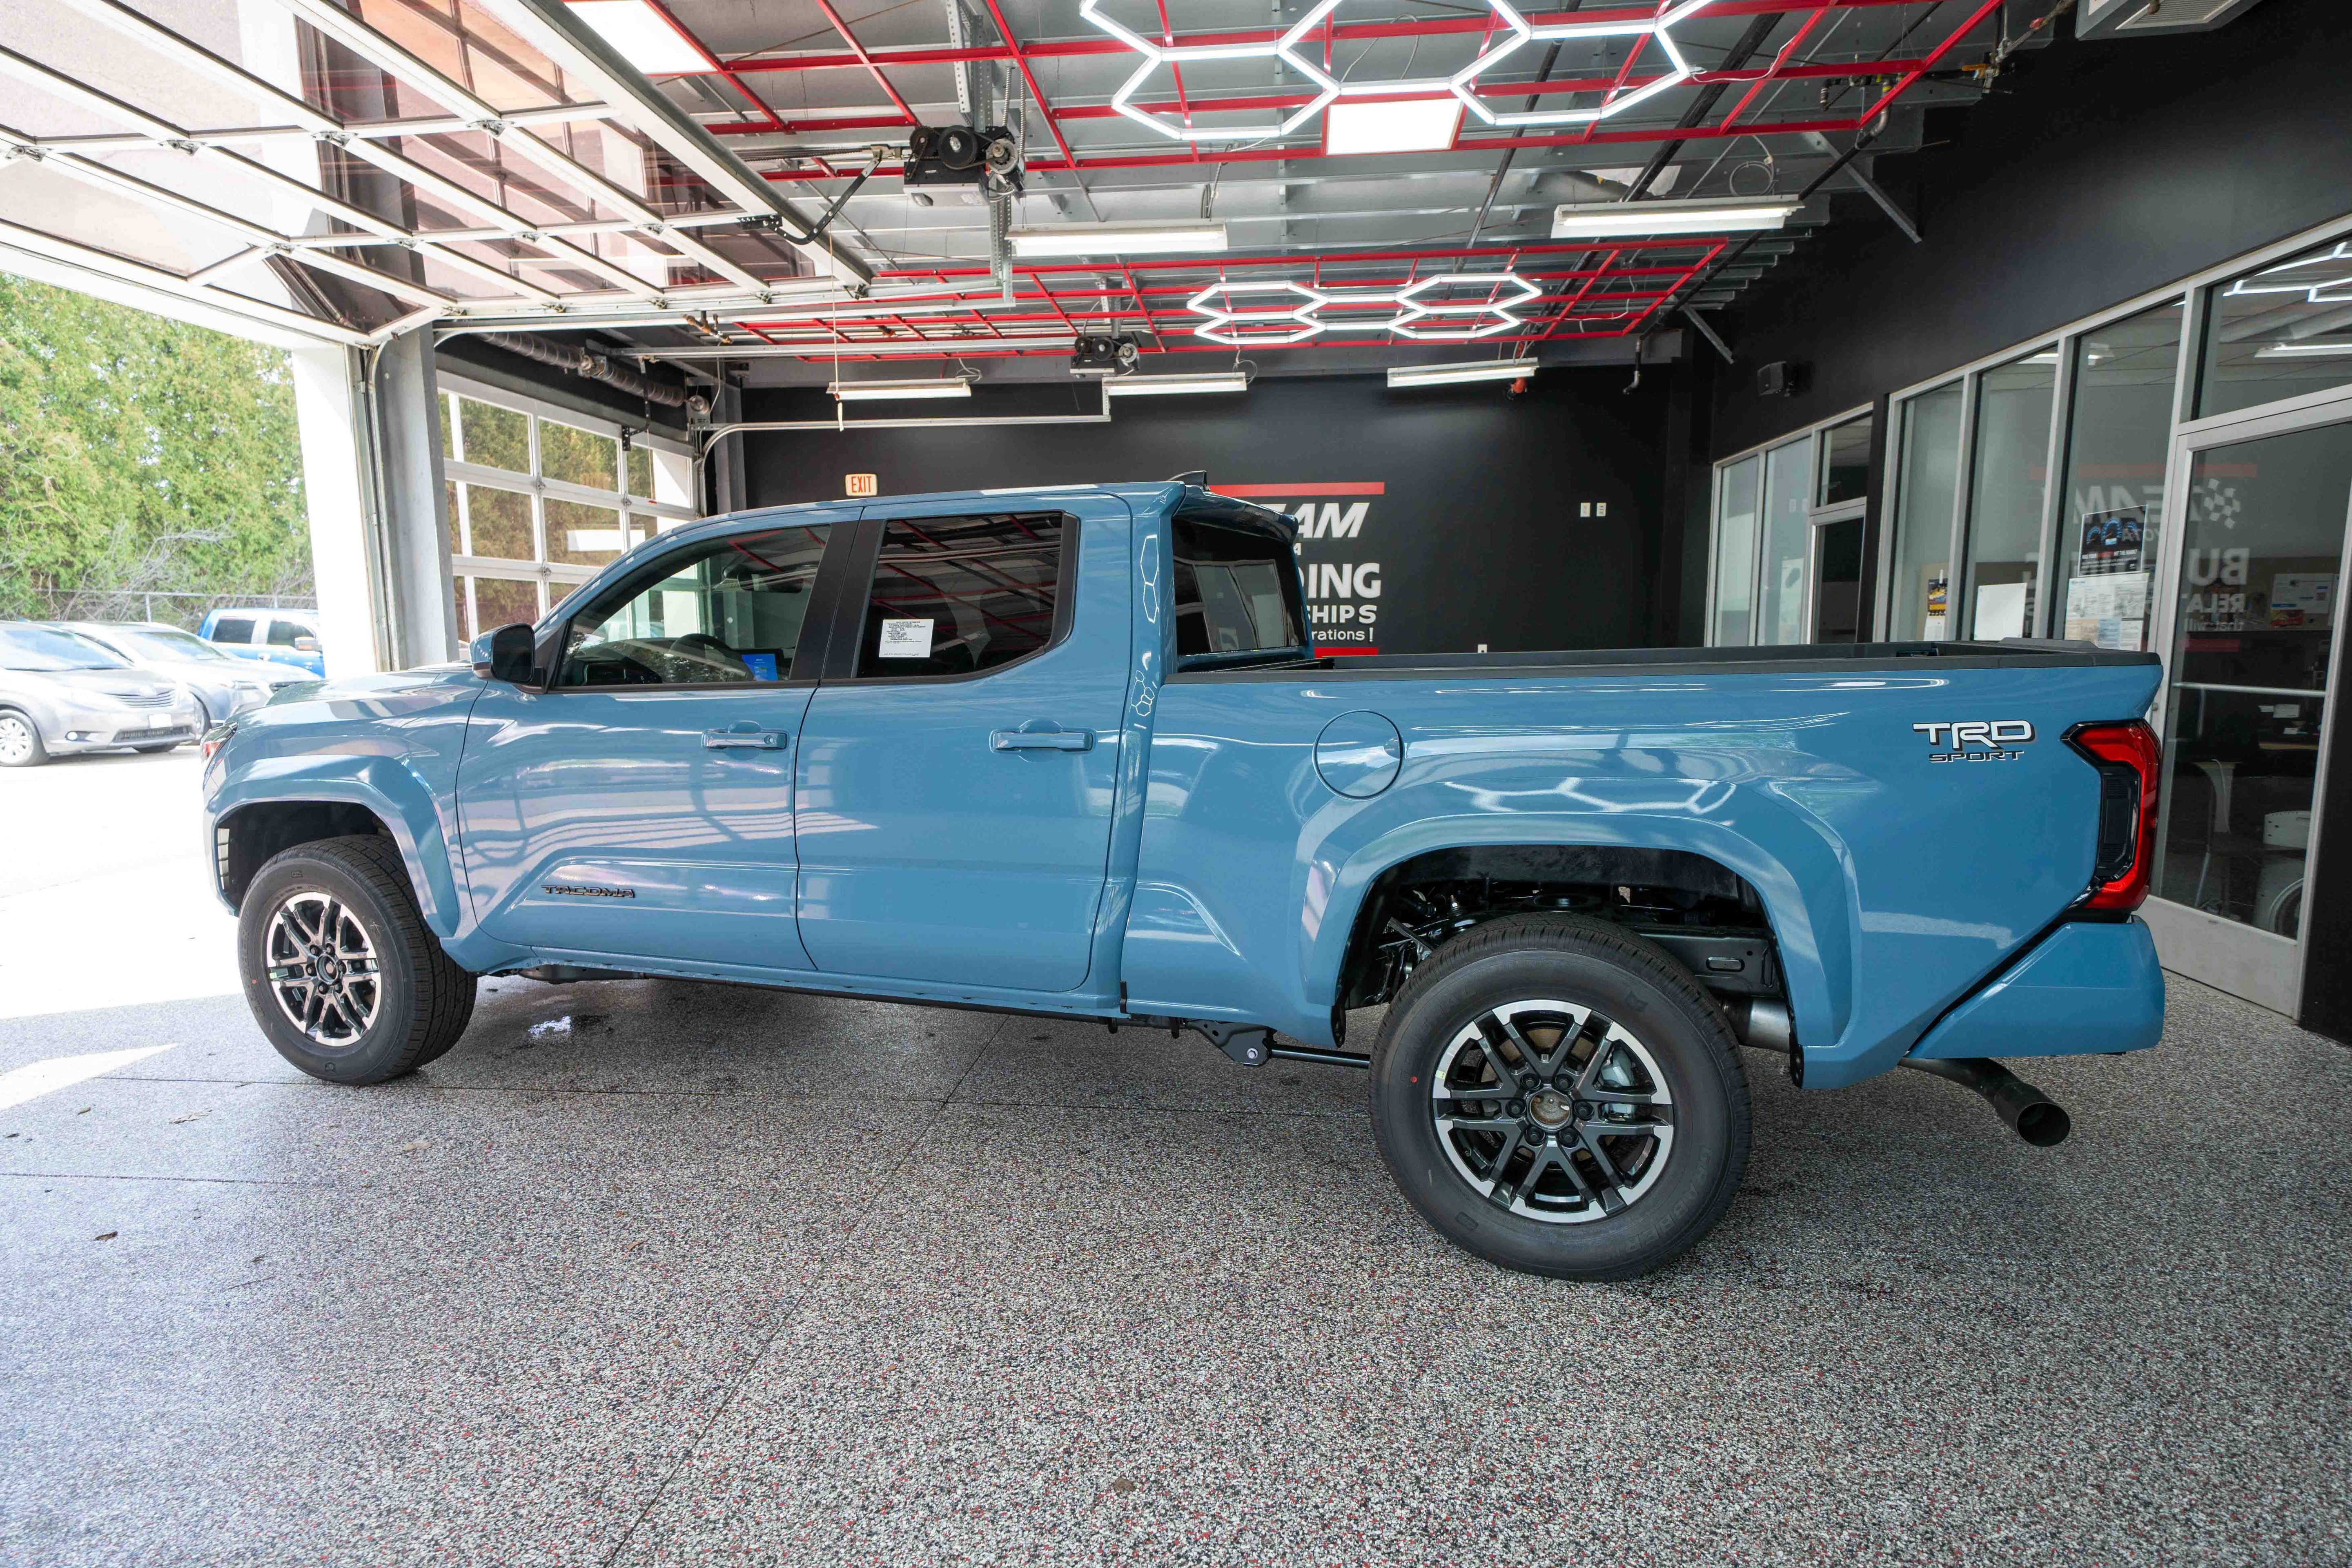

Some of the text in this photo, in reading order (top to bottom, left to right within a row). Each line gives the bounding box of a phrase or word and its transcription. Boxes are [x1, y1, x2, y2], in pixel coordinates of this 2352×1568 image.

[851, 476, 872, 492] EXIT
[1298, 563, 1381, 598] ING
[1912, 719, 2036, 751] TRD
[1929, 750, 2025, 763] SPORT
[541, 884, 635, 898] TACOMA
